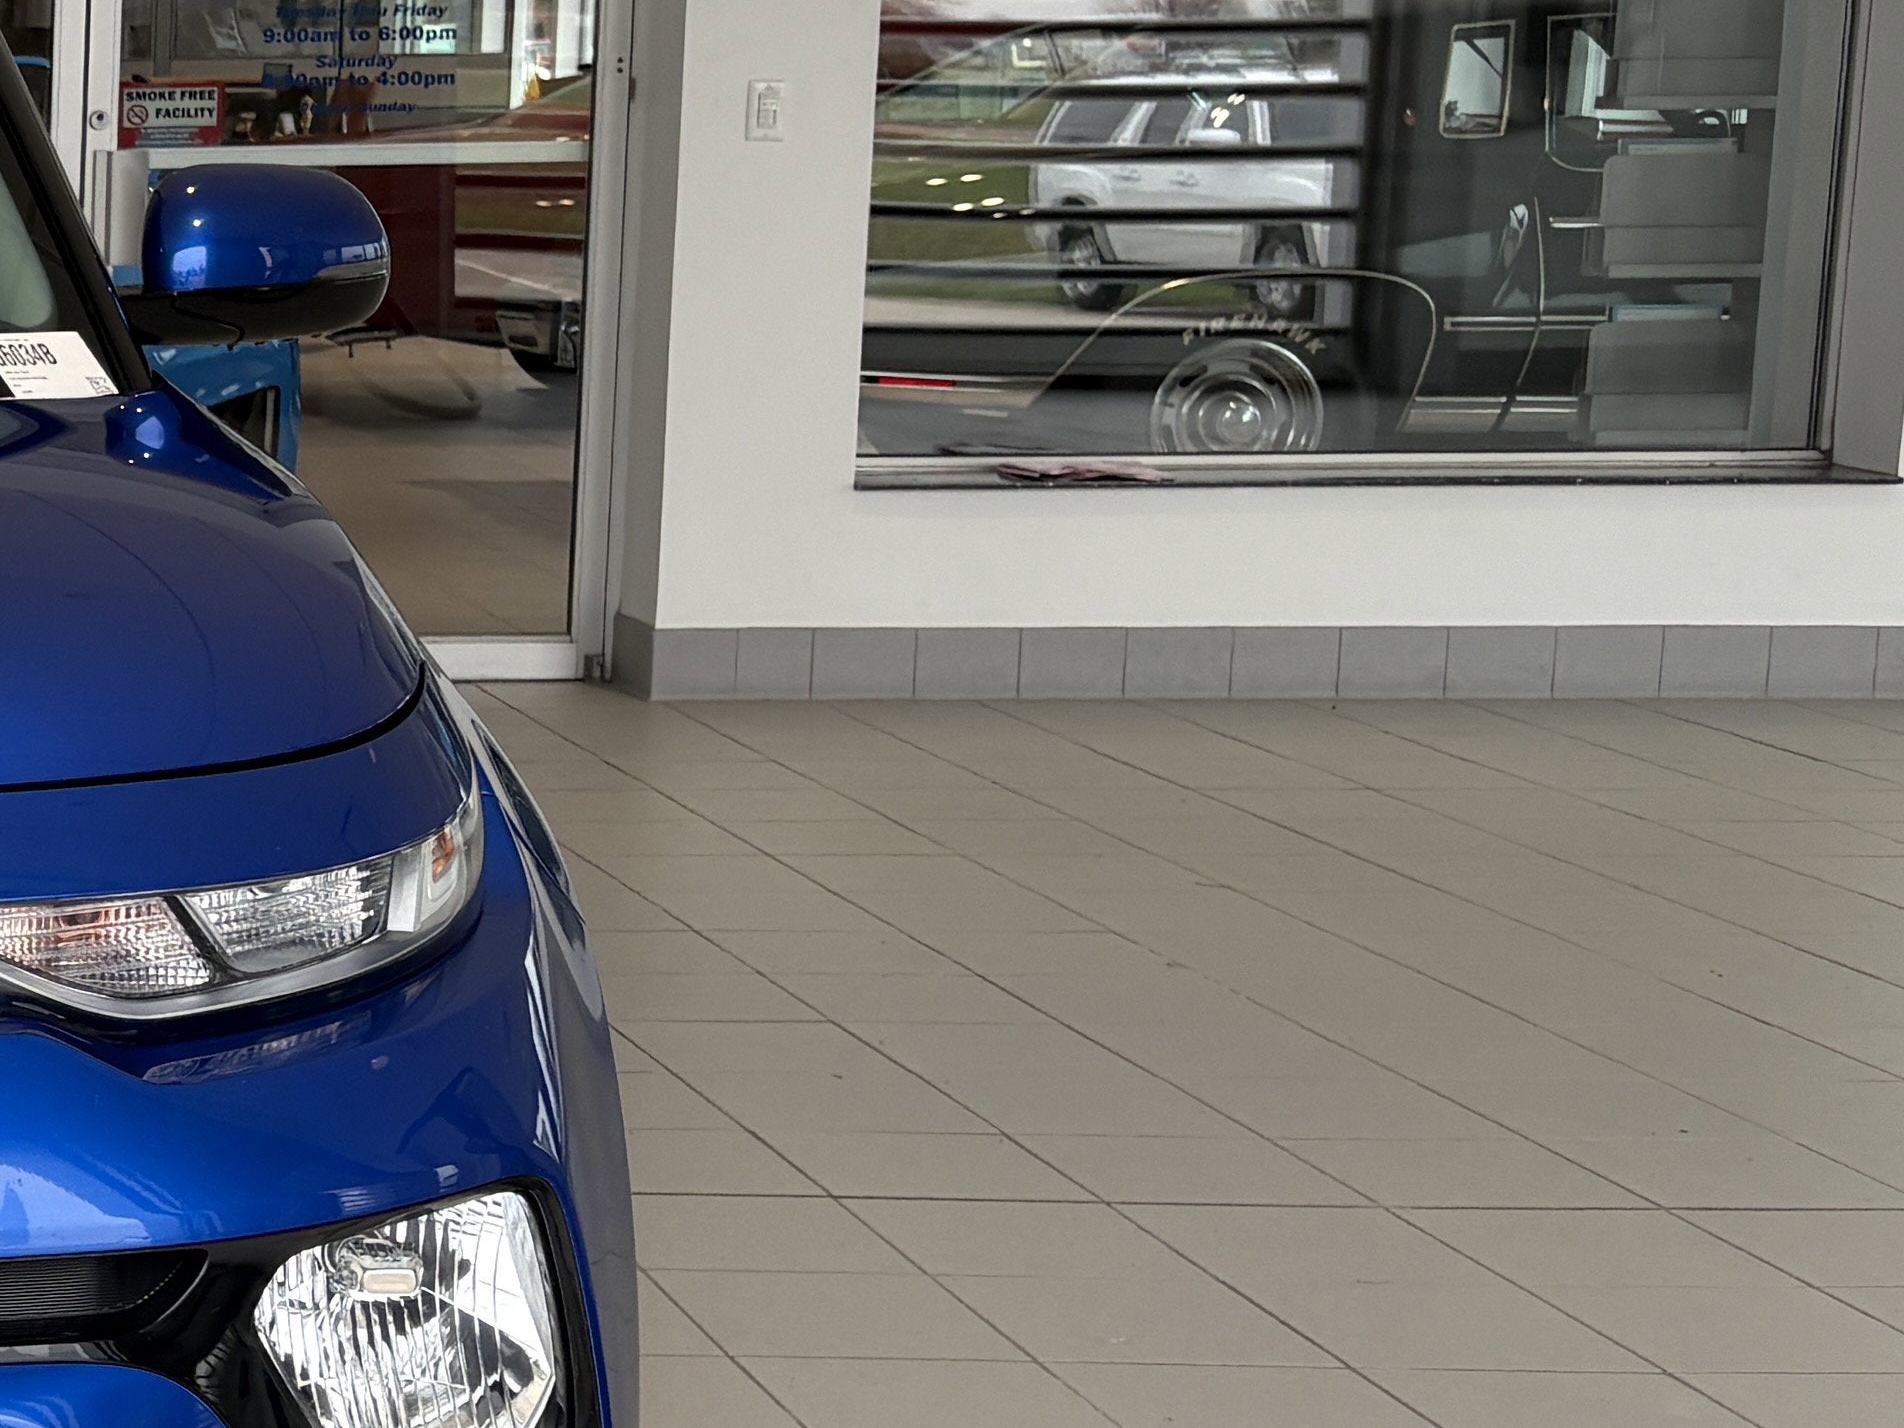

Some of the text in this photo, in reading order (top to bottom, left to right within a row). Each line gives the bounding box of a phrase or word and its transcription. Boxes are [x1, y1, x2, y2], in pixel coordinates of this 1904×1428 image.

[350, 26, 370, 41] to
[375, 70, 456, 89] 4:00pm
[125, 89, 216, 102] SMOKE FREE
[155, 106, 216, 119] FACILITY
